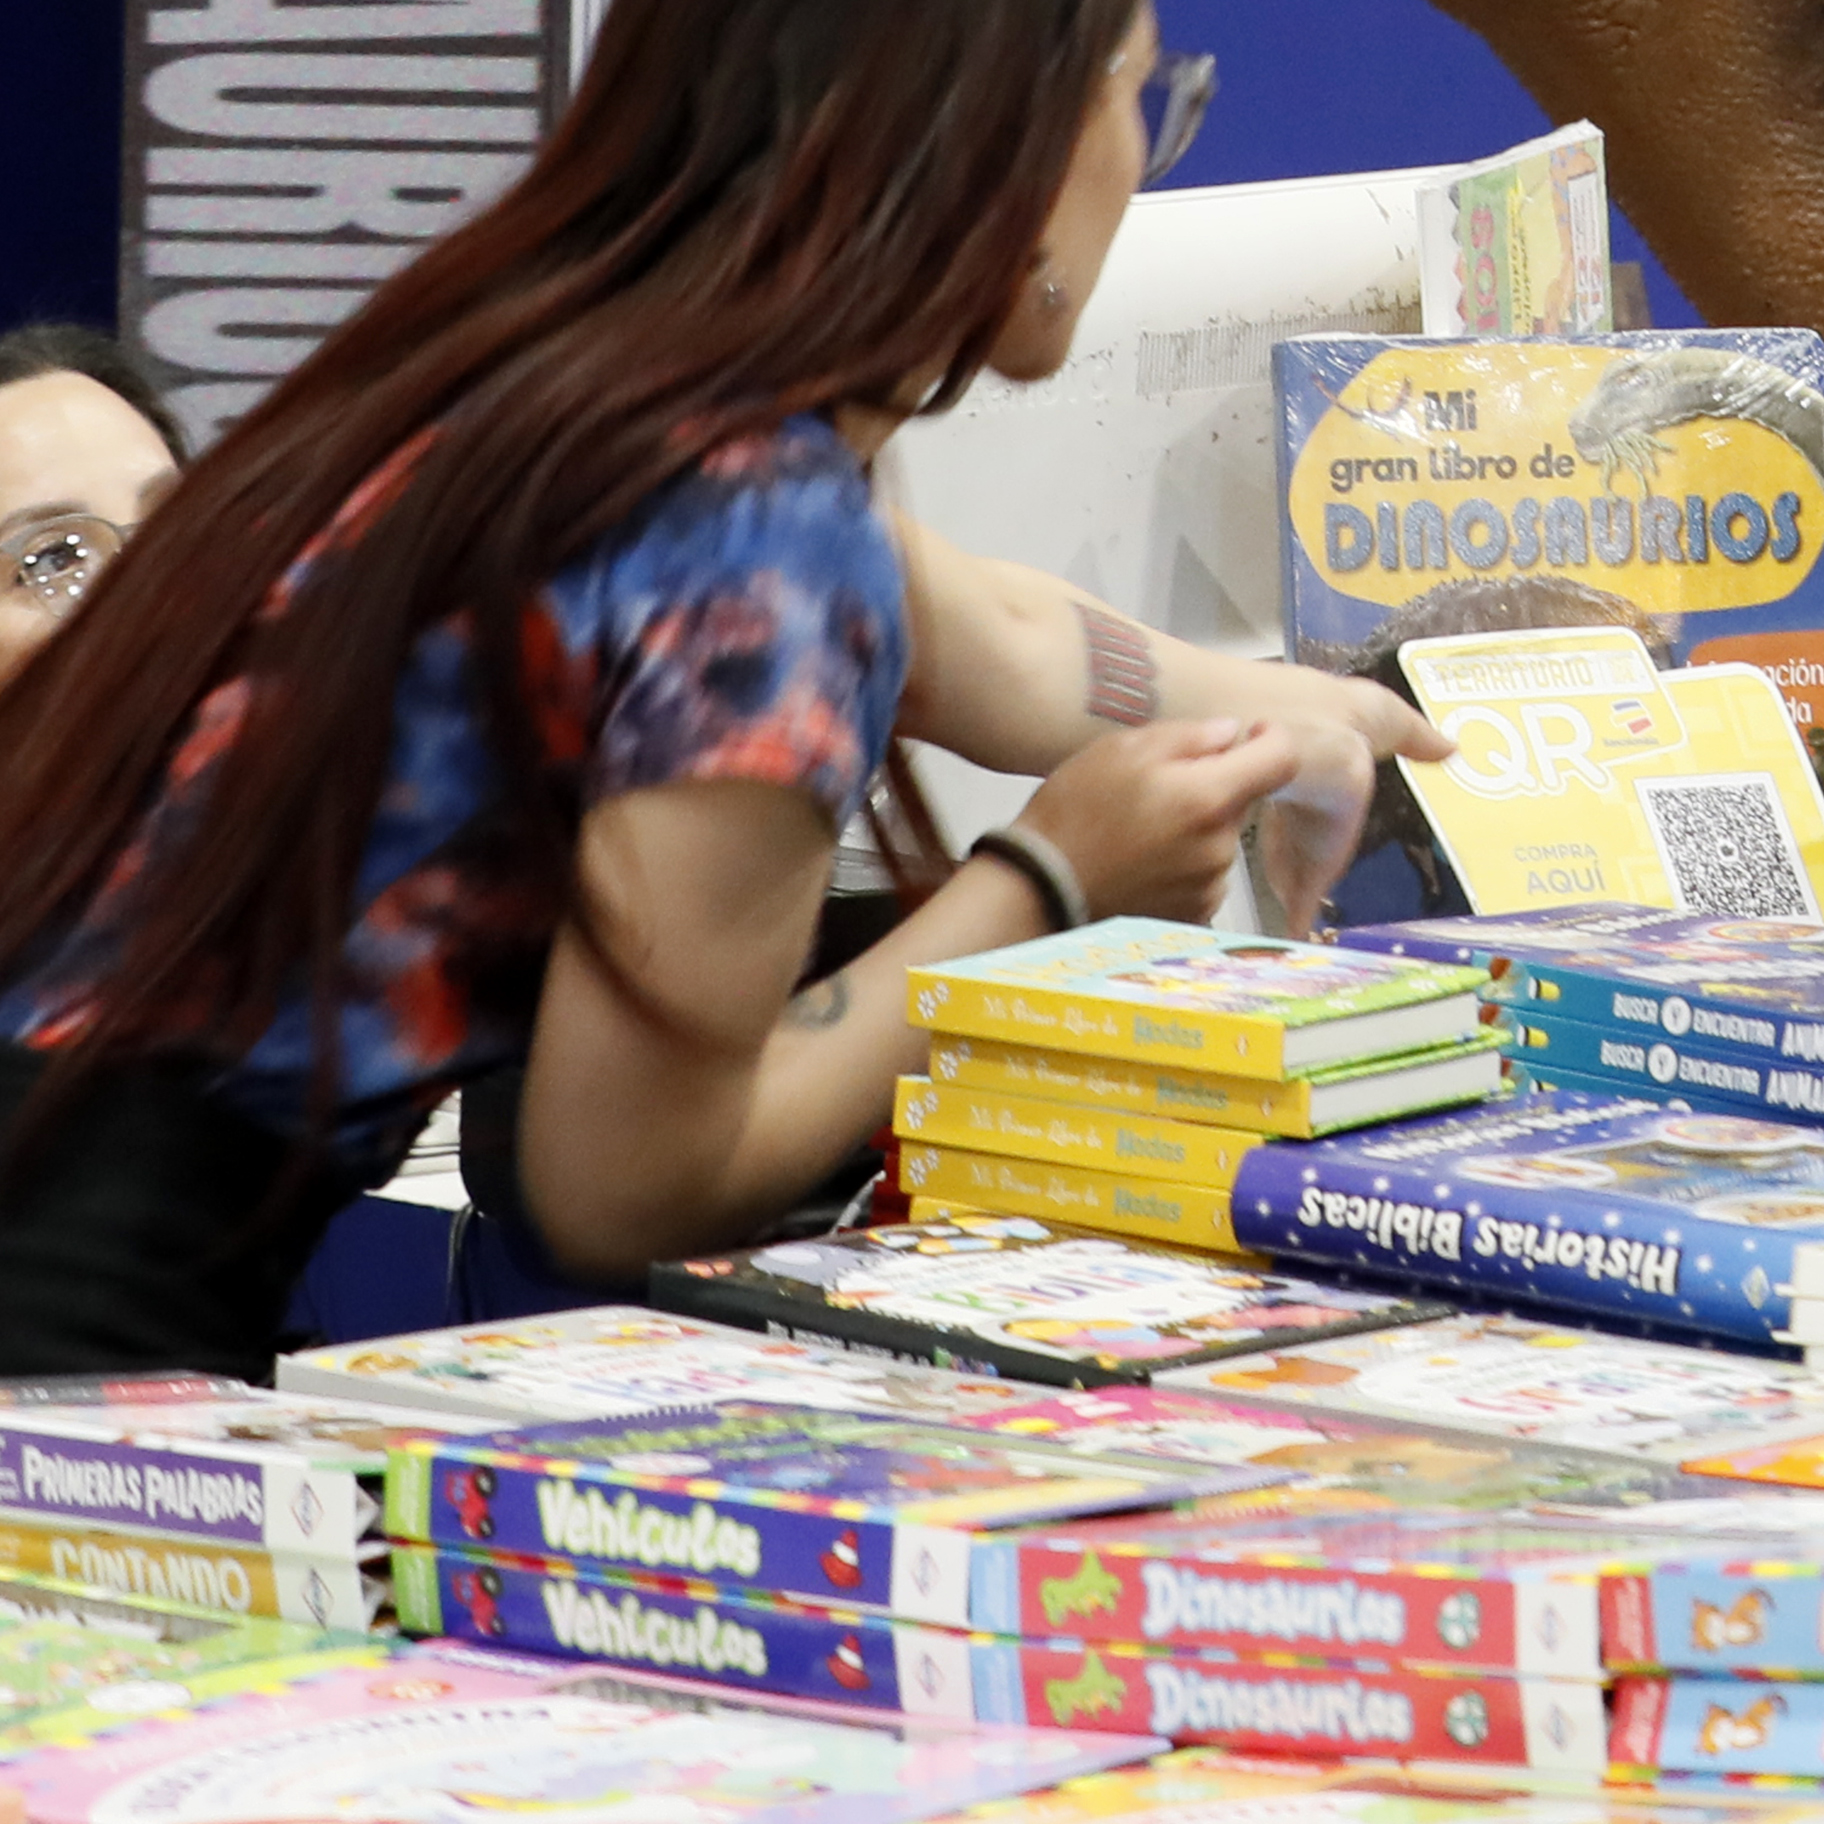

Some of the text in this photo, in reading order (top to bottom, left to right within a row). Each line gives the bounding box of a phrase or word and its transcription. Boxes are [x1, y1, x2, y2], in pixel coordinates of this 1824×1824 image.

[1423, 390, 1478, 432] Mi
[1329, 443, 1577, 493] gran libro de
[1324, 490, 1801, 573] DINOSAURIOS
[1435, 659, 1595, 693] TERRITORIO
[1437, 700, 1614, 794] QR
[1514, 844, 1598, 863] COMPRA
[1526, 858, 1606, 895] AQUÍ
[1612, 991, 1659, 1025] BUSCA
[1692, 1006, 1776, 1049] ENCUENTRA
[1600, 1039, 1646, 1072] BUSCA
[1678, 1054, 1761, 1096] ENCUENTRA
[1472, 1214, 1682, 1296] Historias
[21, 1443, 143, 1511] PRIMERAS
[144, 1463, 263, 1526] PALABRAS
[50, 1537, 252, 1613] CONTANDO
[1140, 1558, 1406, 1647] Dinosaurios
[1147, 1662, 1413, 1745] Dinosaurios
